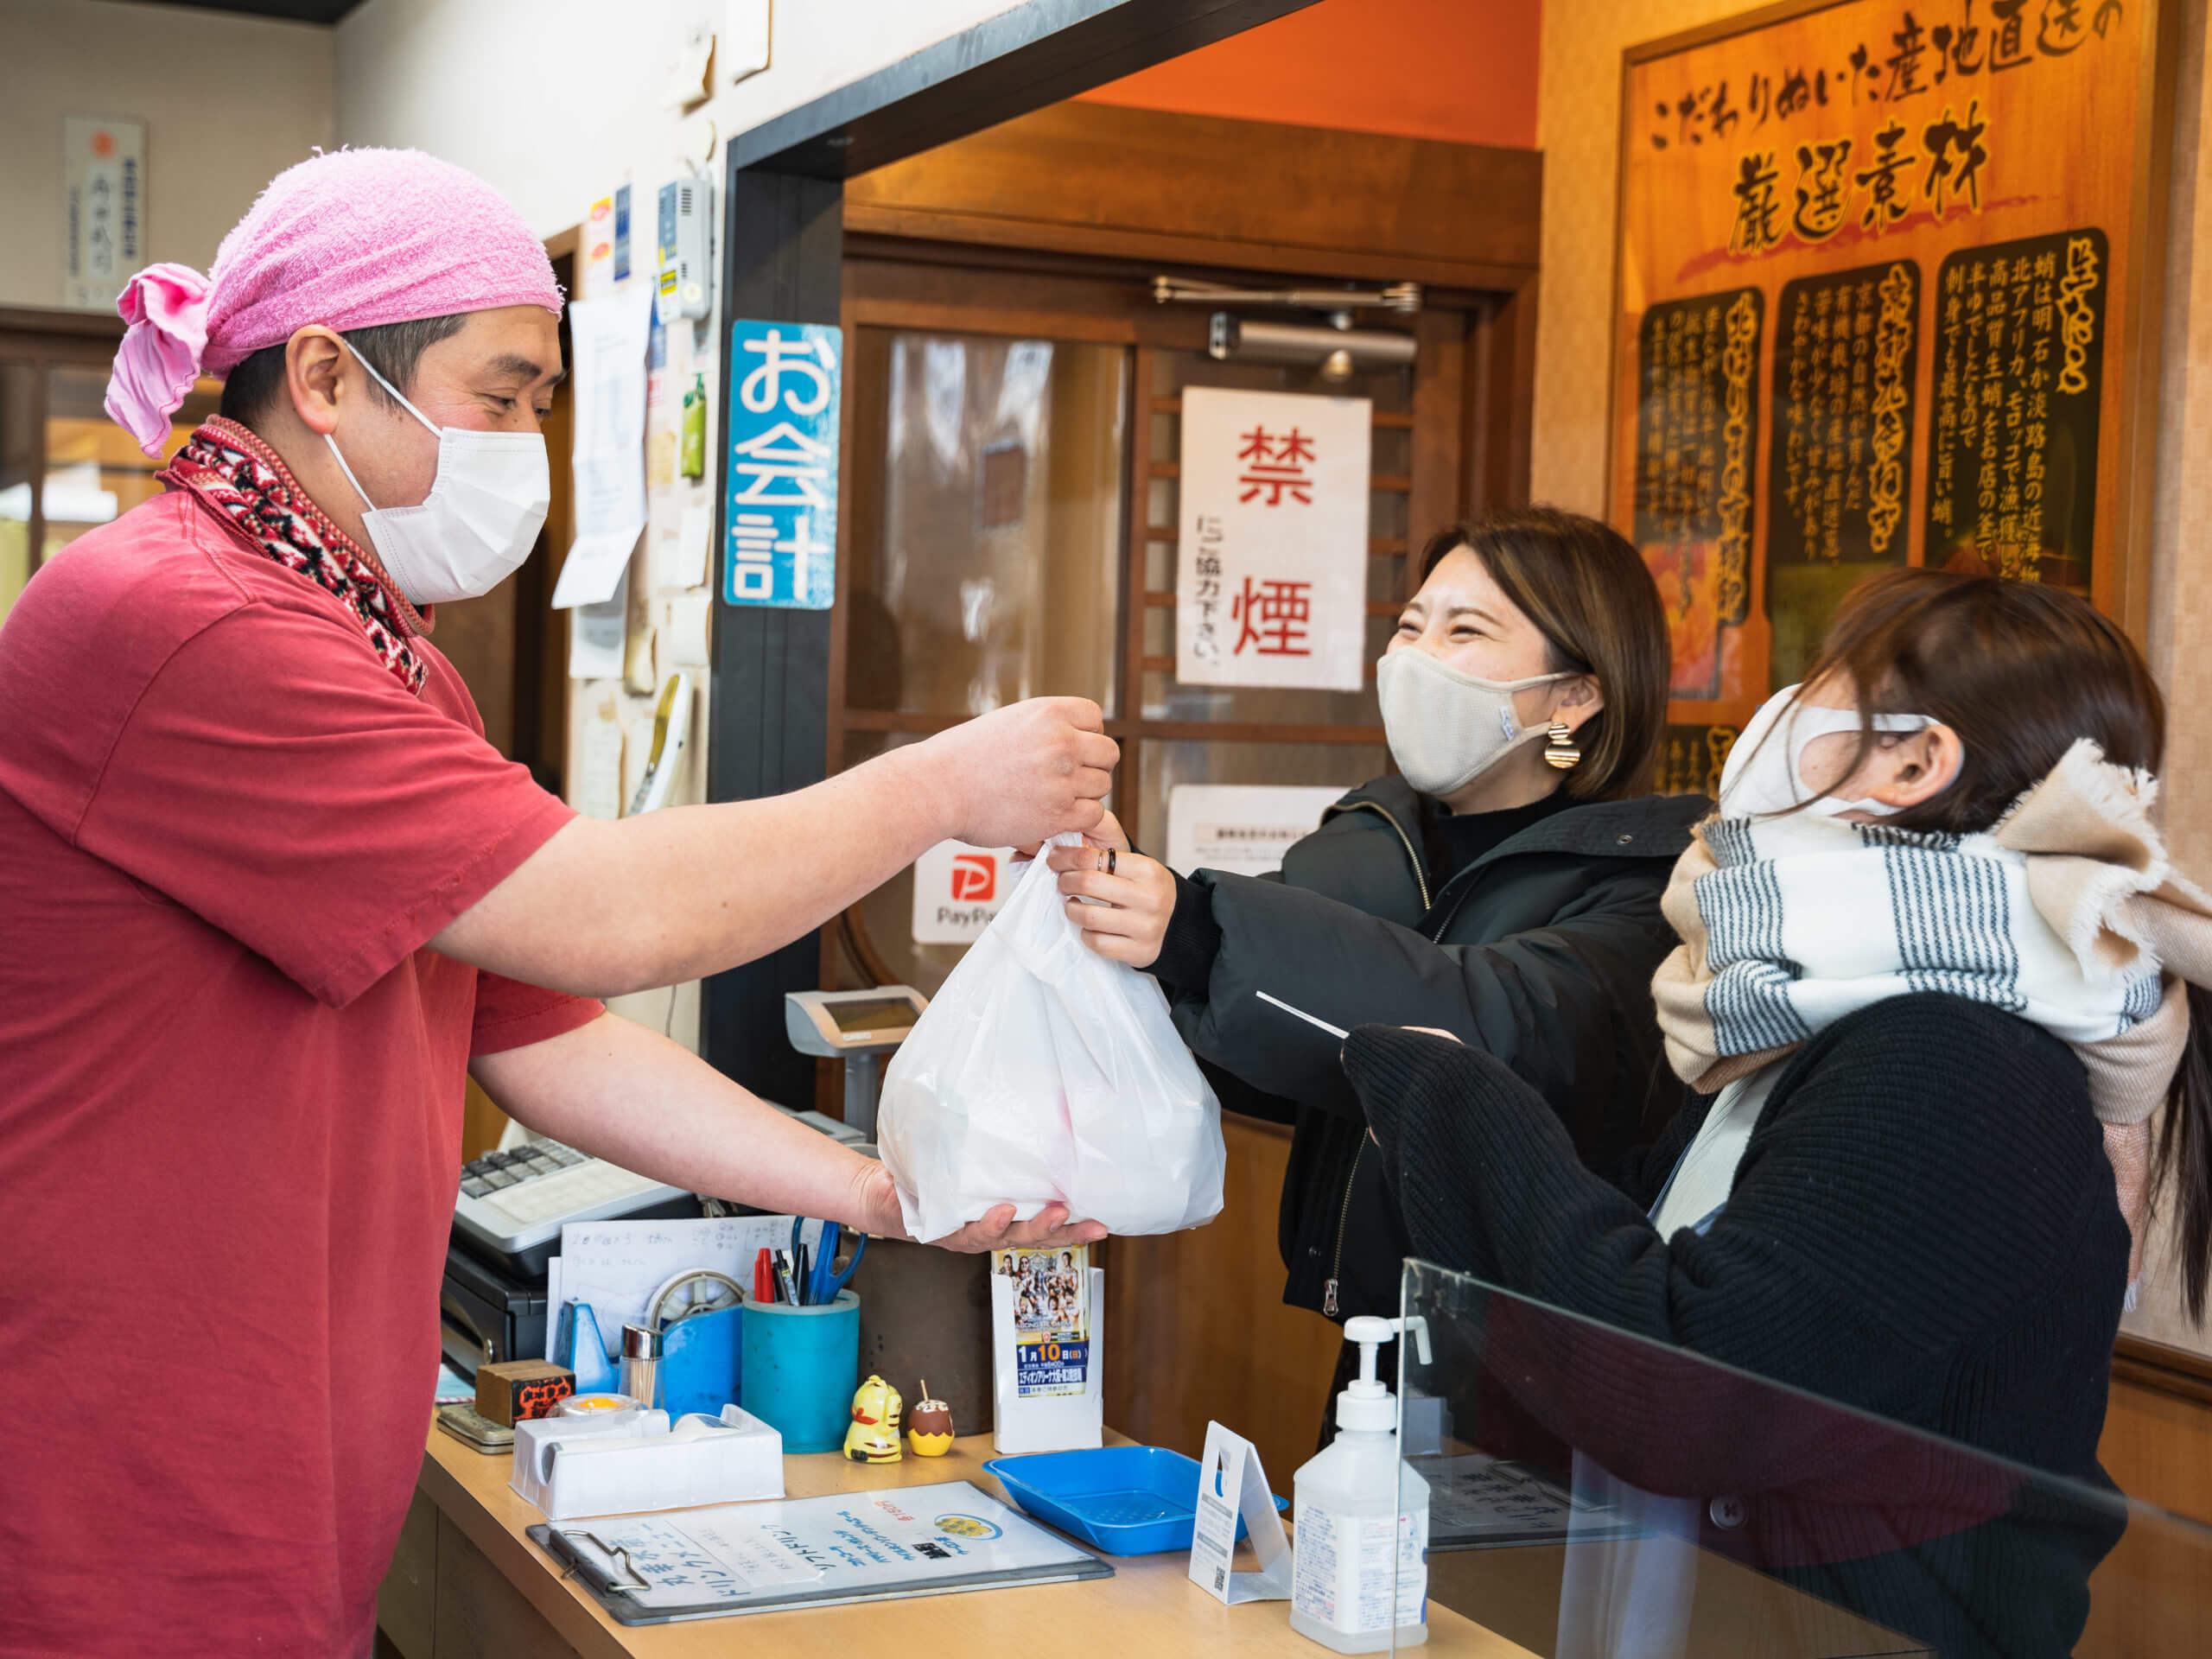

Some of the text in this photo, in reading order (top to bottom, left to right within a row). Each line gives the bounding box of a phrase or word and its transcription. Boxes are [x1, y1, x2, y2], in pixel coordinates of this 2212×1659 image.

[1731, 101, 1990, 253] 厳選素材
[731, 328, 837, 601] お会計
[1231, 424, 1316, 658] 禁煙
